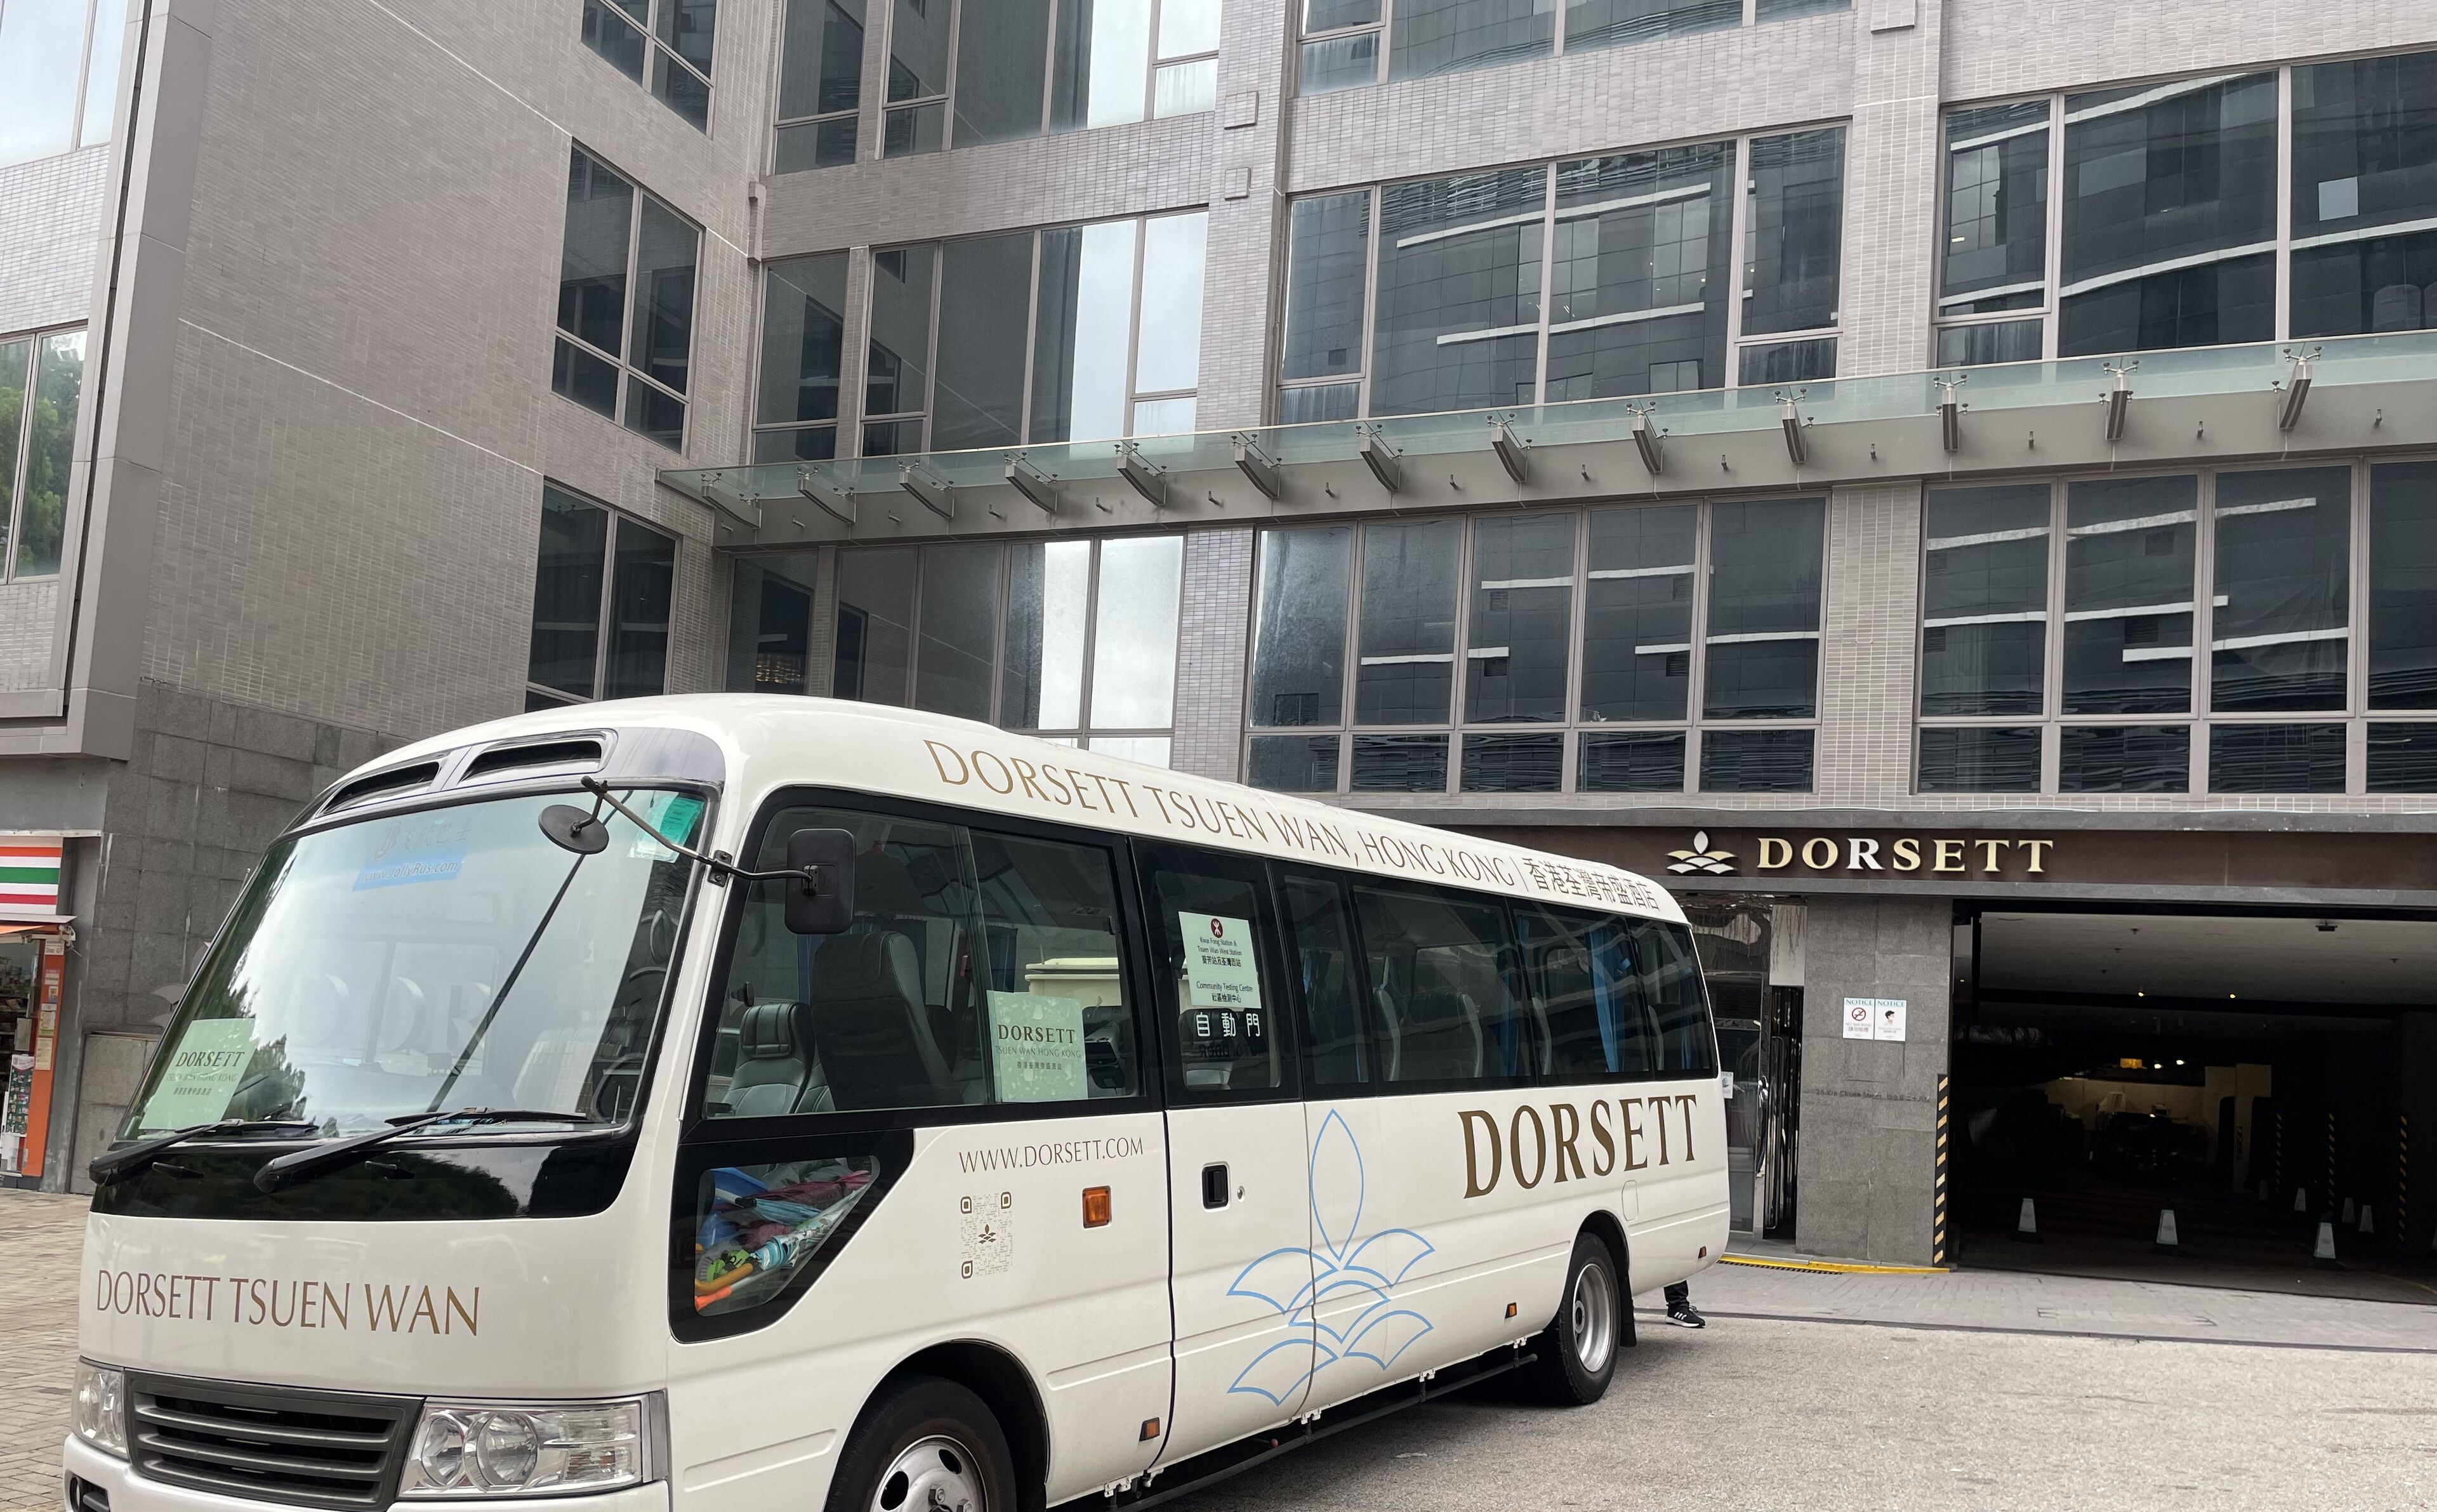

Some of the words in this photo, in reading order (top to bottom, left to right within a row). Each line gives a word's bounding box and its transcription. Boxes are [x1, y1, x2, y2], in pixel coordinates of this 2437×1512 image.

[924, 739, 1139, 818] DORSETT
[1142, 785, 1269, 843] TSUEN
[1266, 812, 1359, 868] WAN,
[1357, 831, 1445, 874] HONG
[1441, 848, 1515, 886] KONG
[1756, 837, 2054, 873] DORSETT
[1210, 938, 1220, 947] Fong
[1196, 981, 1222, 991] Community
[1222, 983, 1239, 993] Testing
[1239, 984, 1253, 992] Centre
[998, 1024, 1075, 1044] DORSETT
[1196, 1011, 1260, 1037] 自動門
[175, 1051, 245, 1067] DORSETT
[995, 1046, 1017, 1055] TSUEN
[1019, 1047, 1036, 1056] WAN
[1038, 1049, 1060, 1057] HONG
[1061, 1049, 1081, 1058] KONG
[959, 1136, 1144, 1174] WWW.DORSETT.COM
[1457, 1094, 1698, 1199] DORSETT
[97, 1269, 221, 1321] DORSETT
[228, 1277, 349, 1331] TSUEN
[364, 1283, 480, 1336] WAN
